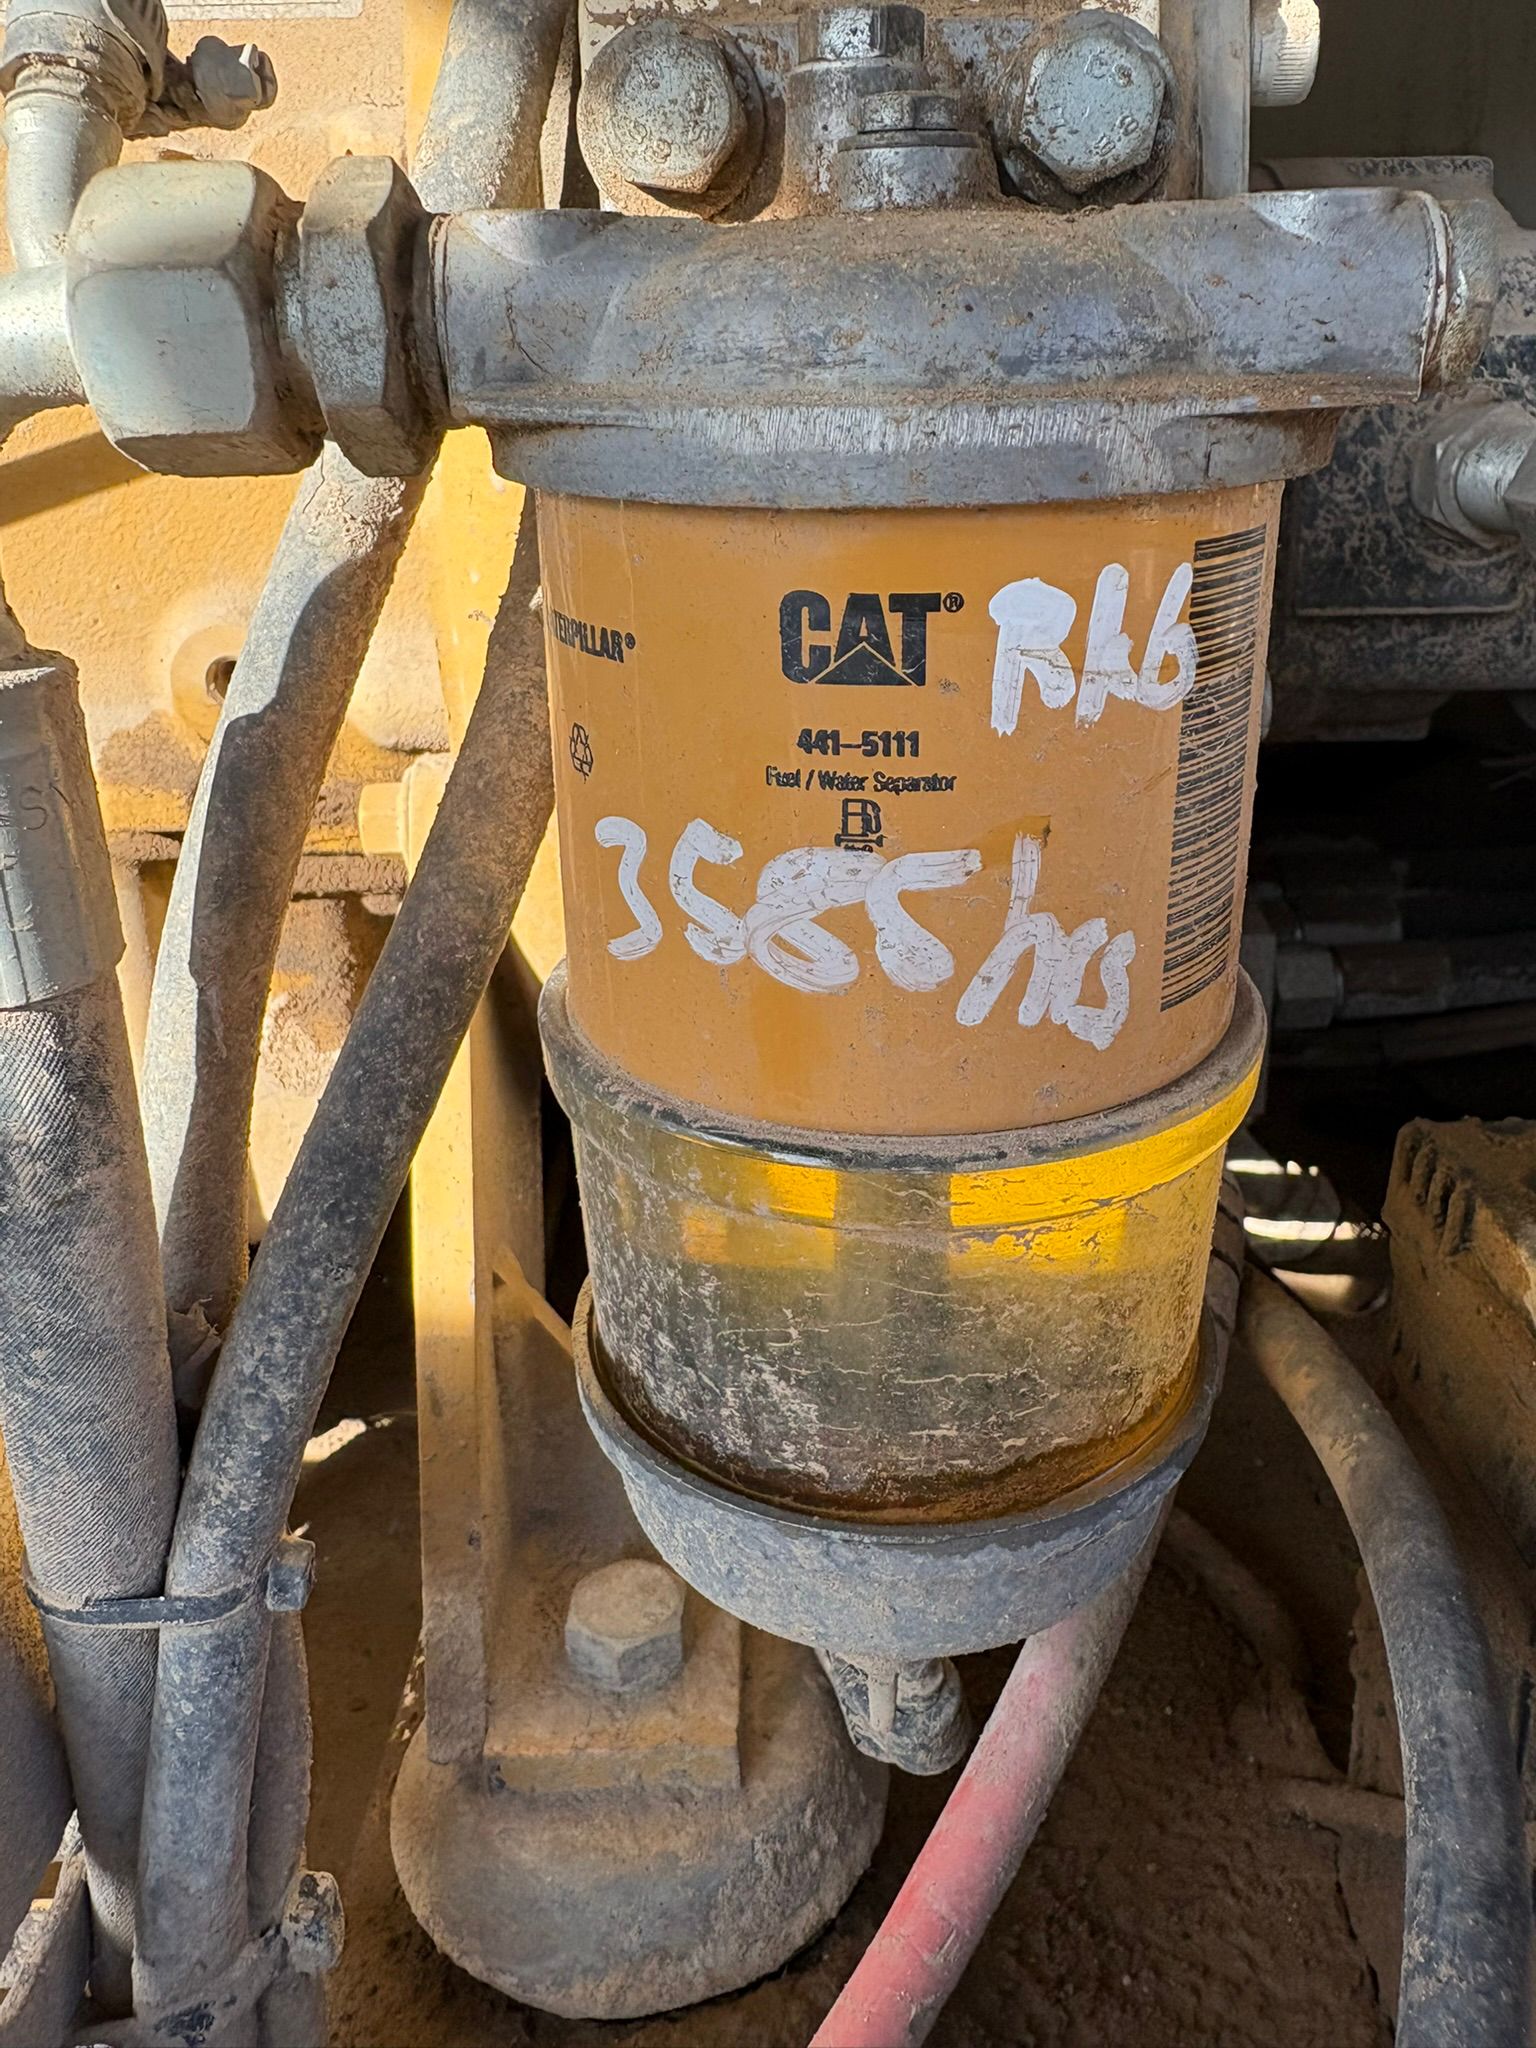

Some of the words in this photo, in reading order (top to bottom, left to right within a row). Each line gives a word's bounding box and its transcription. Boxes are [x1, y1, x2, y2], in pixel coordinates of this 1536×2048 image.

[797, 728, 920, 757] 441-5111
[766, 765, 800, 788] Fuel
[818, 770, 869, 791] Water
[873, 771, 957, 795] Separator
